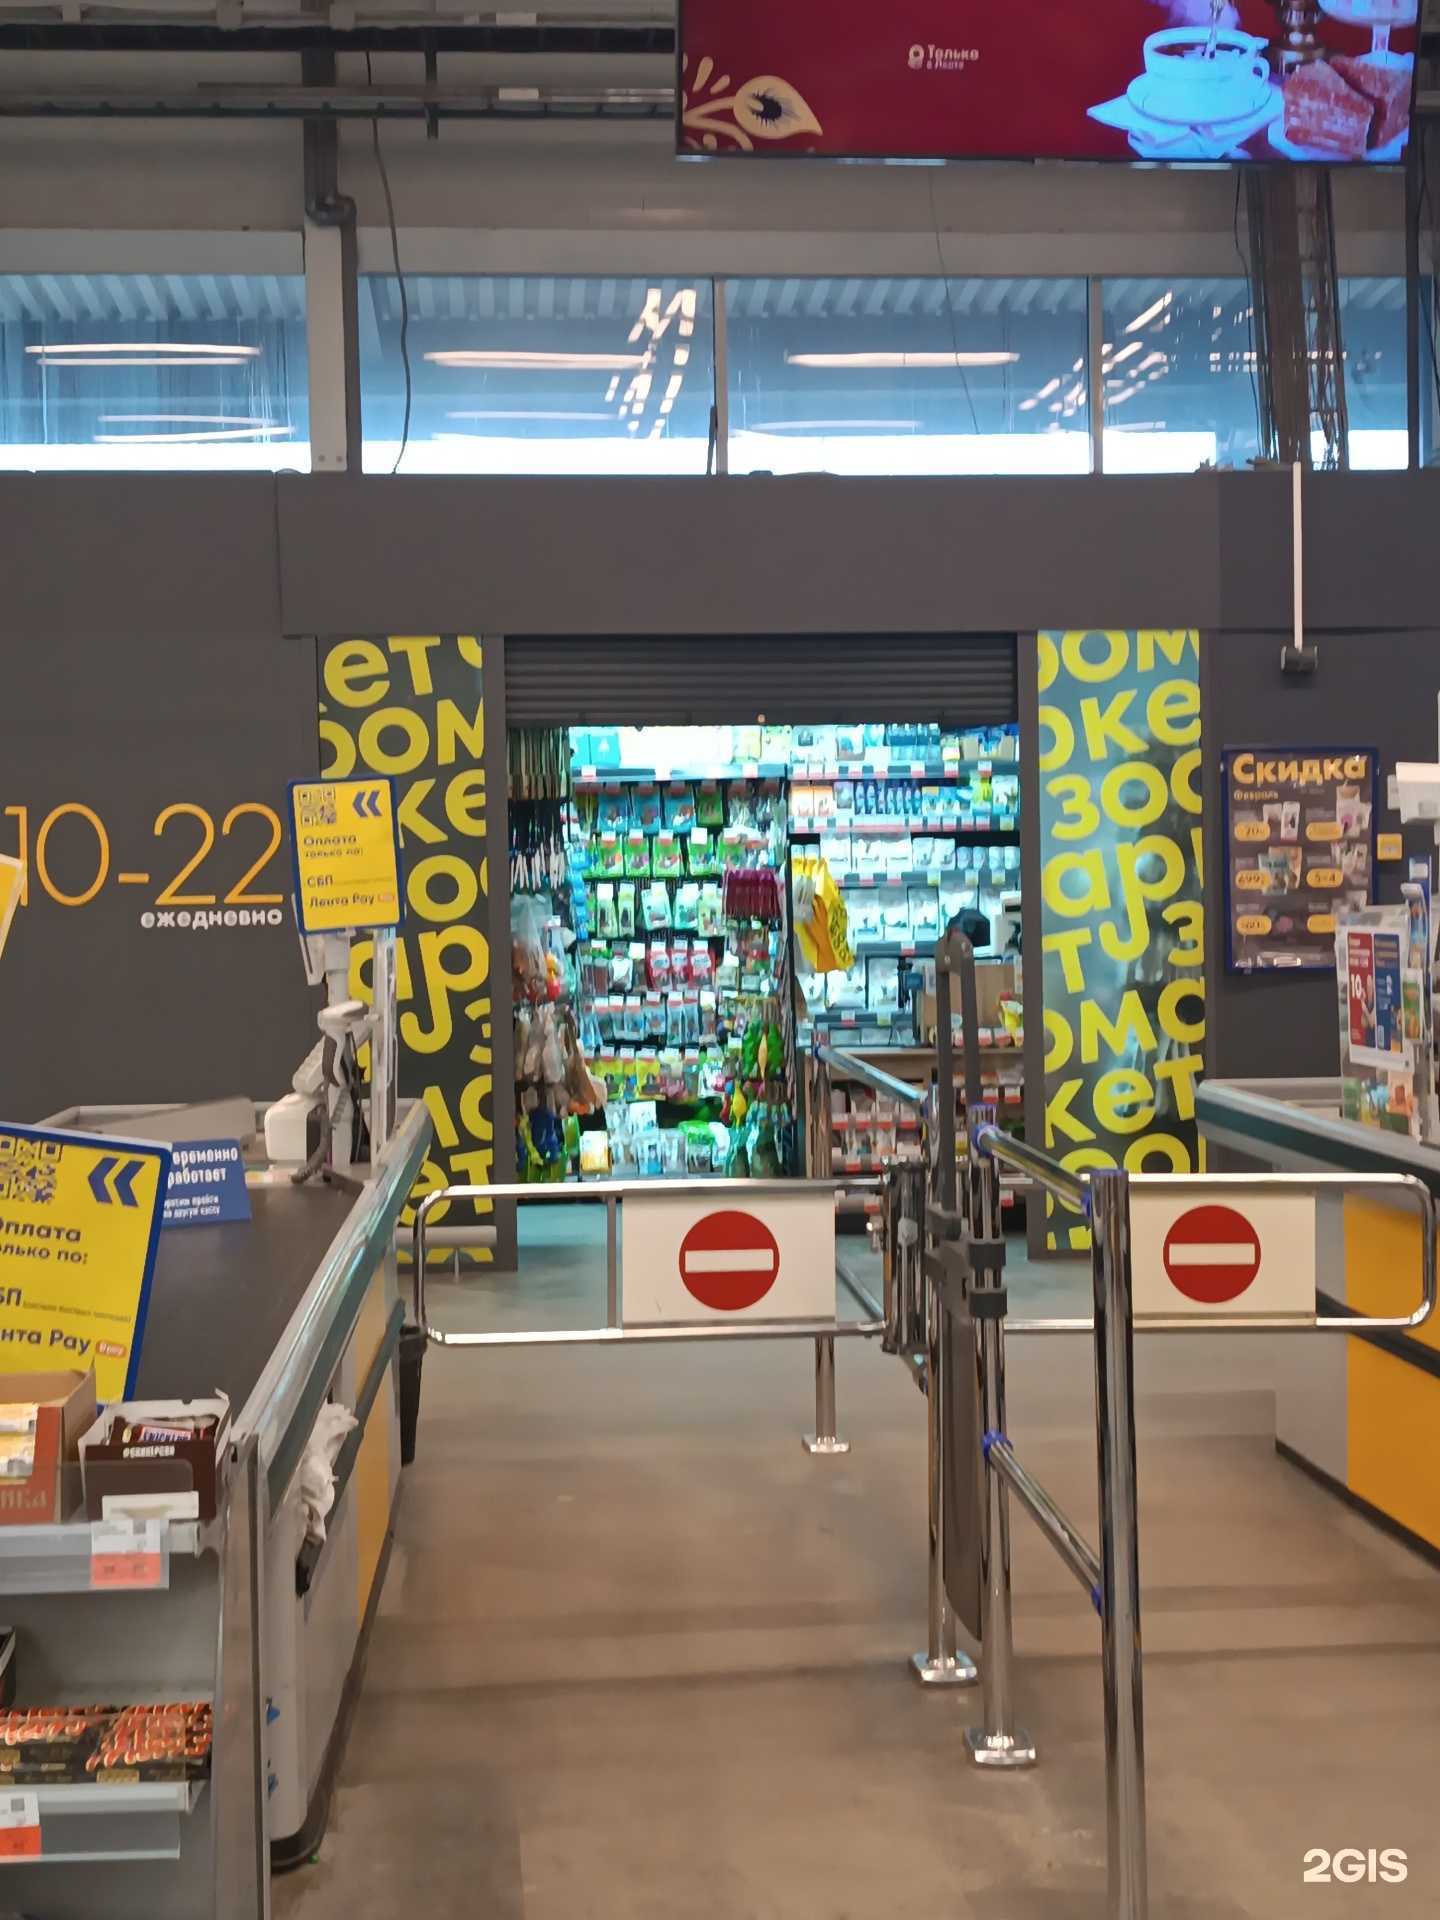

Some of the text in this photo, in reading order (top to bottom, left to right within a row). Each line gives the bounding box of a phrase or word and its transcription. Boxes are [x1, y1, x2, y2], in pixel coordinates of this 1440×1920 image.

[5, 802, 284, 907] 10-22
[140, 908, 283, 931] ежедневно
[0, 1242, 51, 1260] лько
[0, 1327, 43, 1345] нта
[50, 1328, 91, 1357] Pay
